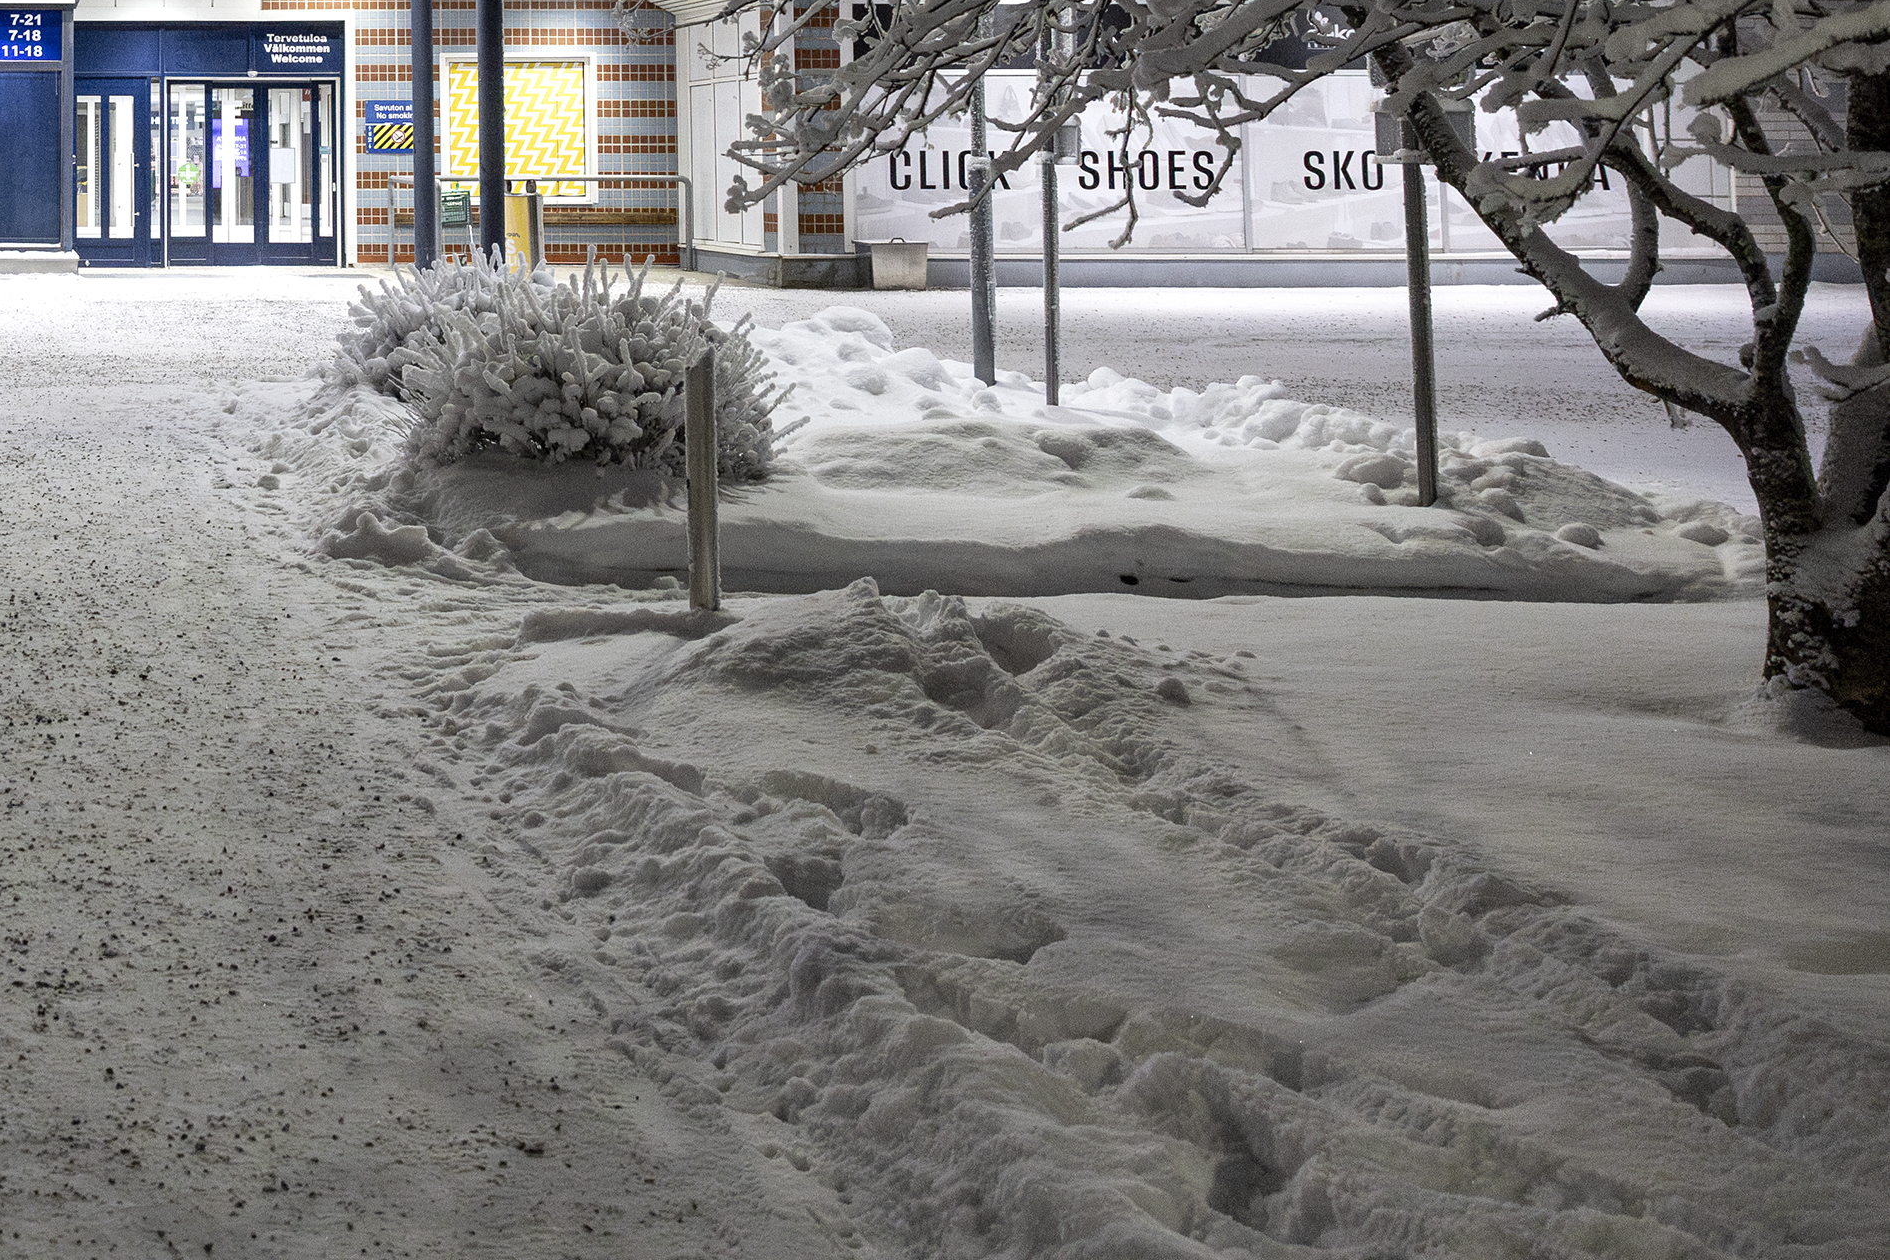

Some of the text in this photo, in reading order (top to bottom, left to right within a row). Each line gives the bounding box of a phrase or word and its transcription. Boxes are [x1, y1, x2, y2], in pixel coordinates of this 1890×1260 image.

[10, 14, 42, 26] 7-21
[8, 29, 42, 41] 7-18
[266, 33, 328, 43] Tervetuloa
[1, 44, 43, 57] 11-18
[263, 43, 331, 53] Välkommen
[271, 53, 324, 63] Welcome
[1077, 150, 1216, 191] SHOES
[1302, 150, 1384, 190] SKO
